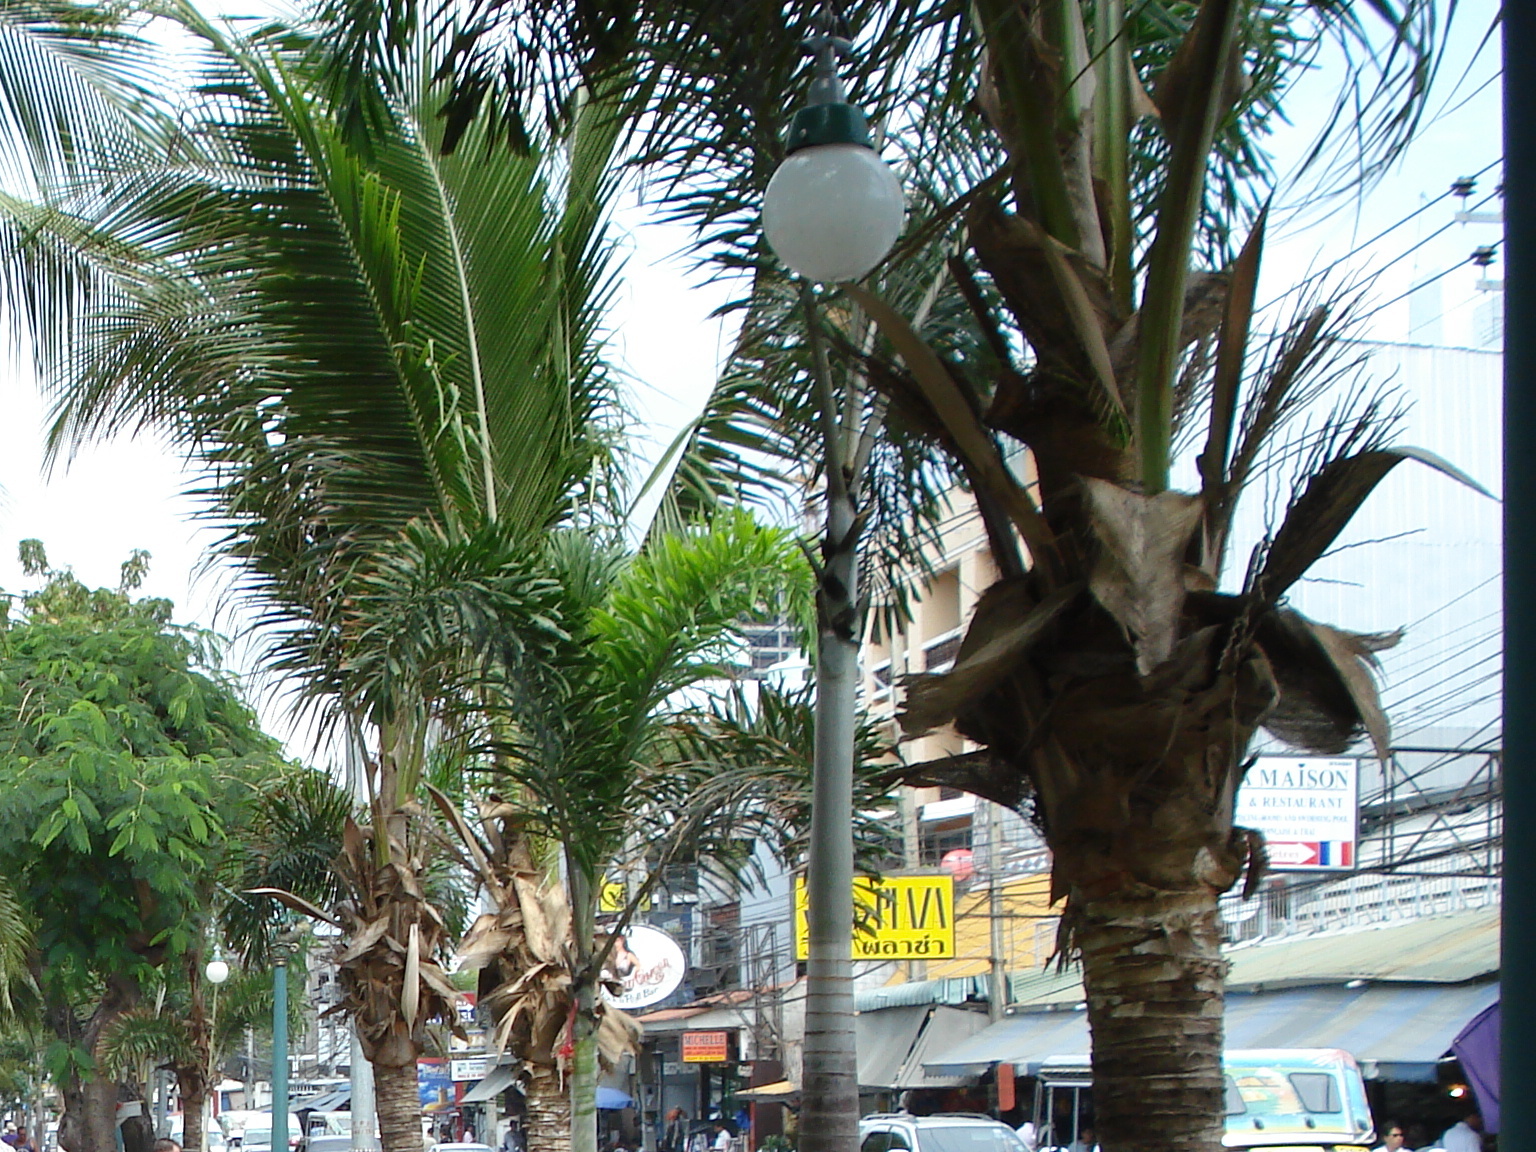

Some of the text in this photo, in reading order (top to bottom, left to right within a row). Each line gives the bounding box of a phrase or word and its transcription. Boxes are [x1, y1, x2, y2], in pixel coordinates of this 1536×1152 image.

[1260, 763, 1349, 789] MAISON
[1263, 797, 1343, 808] RESTAURANT
[642, 987, 659, 999] Bar
[684, 1034, 725, 1046] MICHELLE
